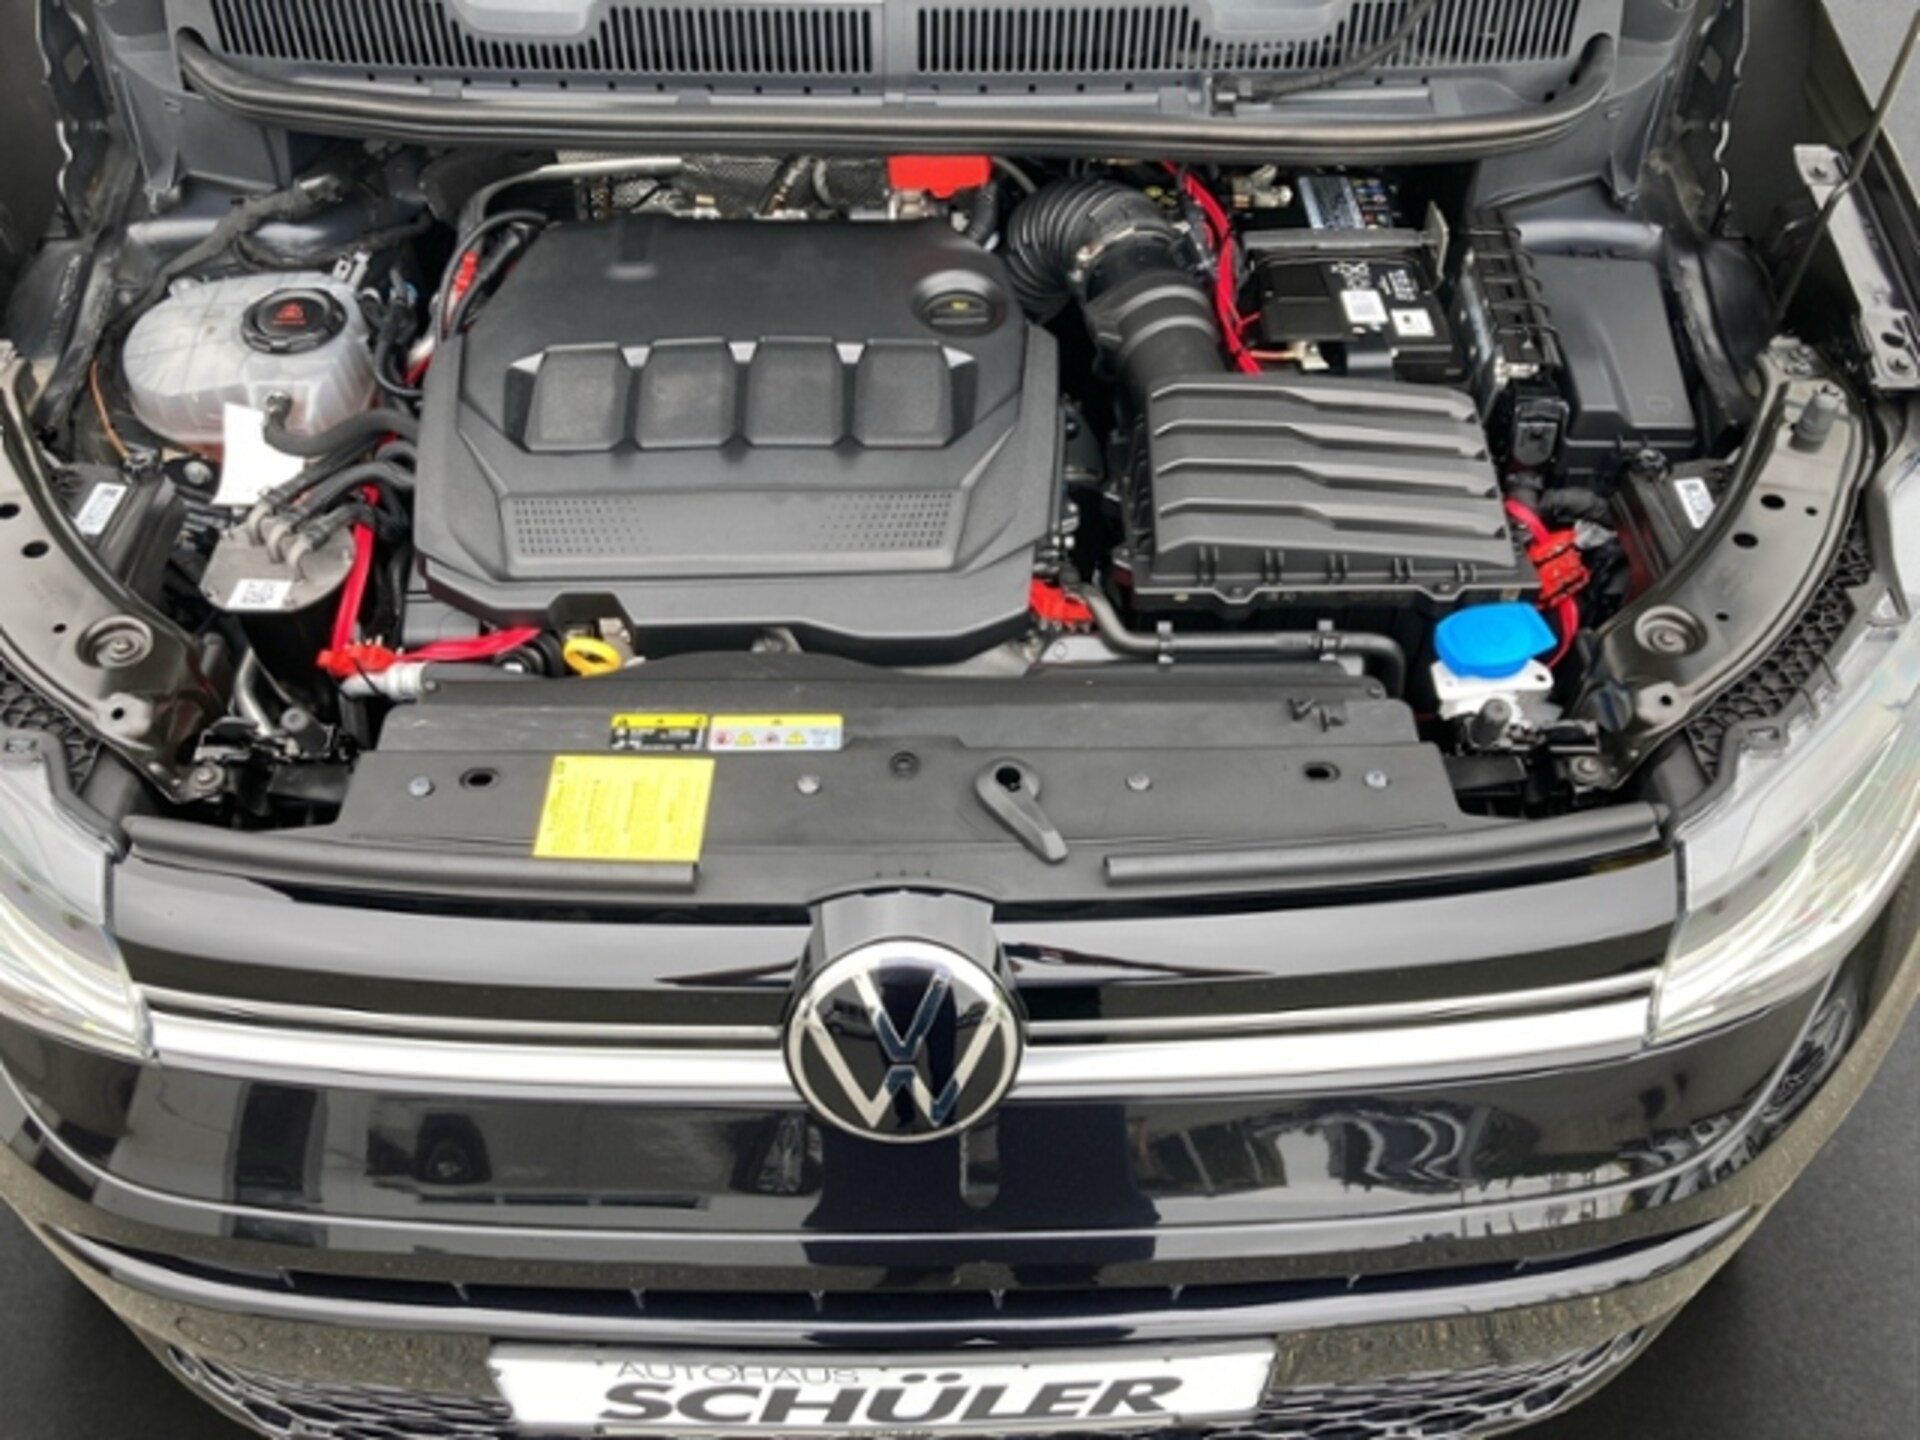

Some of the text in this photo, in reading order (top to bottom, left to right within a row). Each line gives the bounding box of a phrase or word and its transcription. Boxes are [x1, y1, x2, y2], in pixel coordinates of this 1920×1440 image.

[798, 956, 1006, 1132] VW
[598, 1373, 1184, 1423] SCHÜLER
[616, 1362, 860, 1384] AUTOHAUS
